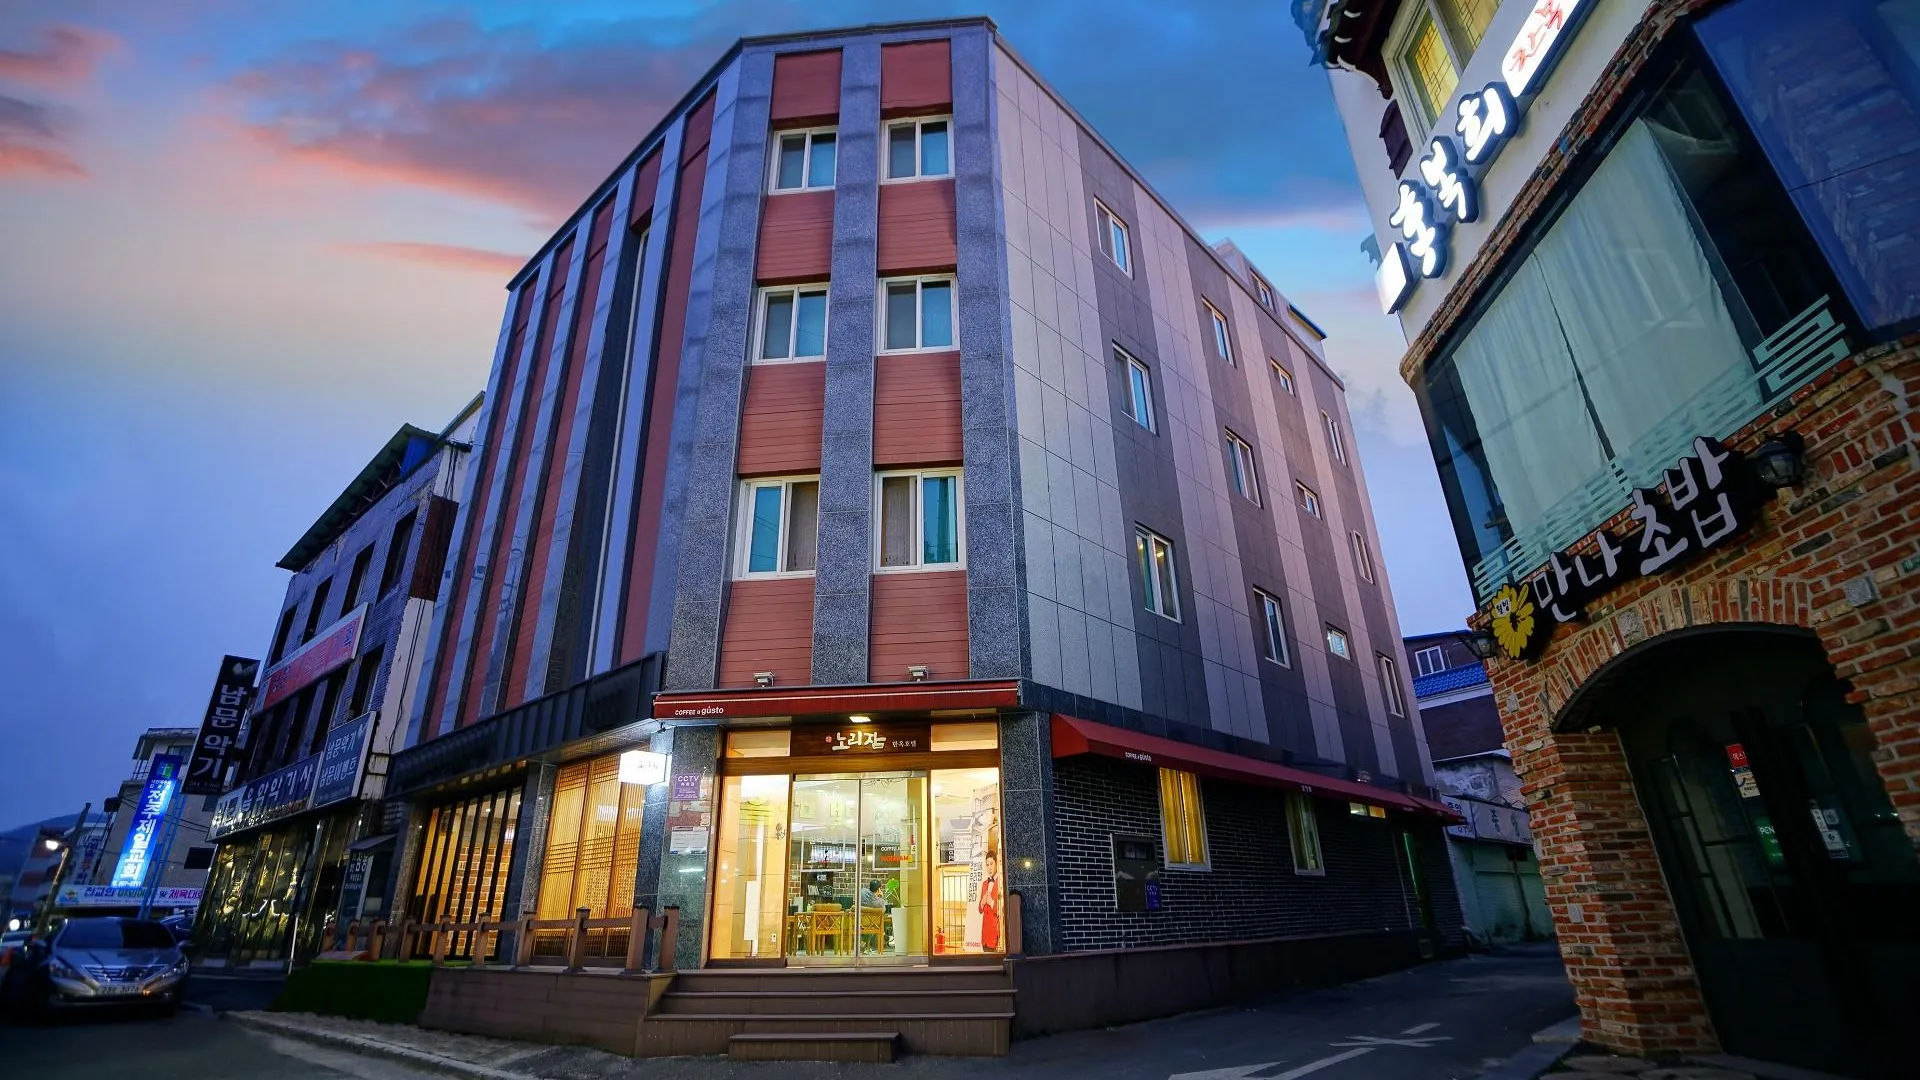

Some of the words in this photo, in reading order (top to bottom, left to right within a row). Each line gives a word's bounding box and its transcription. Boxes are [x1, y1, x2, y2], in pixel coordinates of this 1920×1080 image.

[192, 684, 247, 778] 남문악기
[325, 733, 356, 761] 남문악기
[831, 731, 887, 751] 노리잠
[892, 740, 917, 748] 한옥호텔
[120, 789, 167, 880] 전주제일교회
